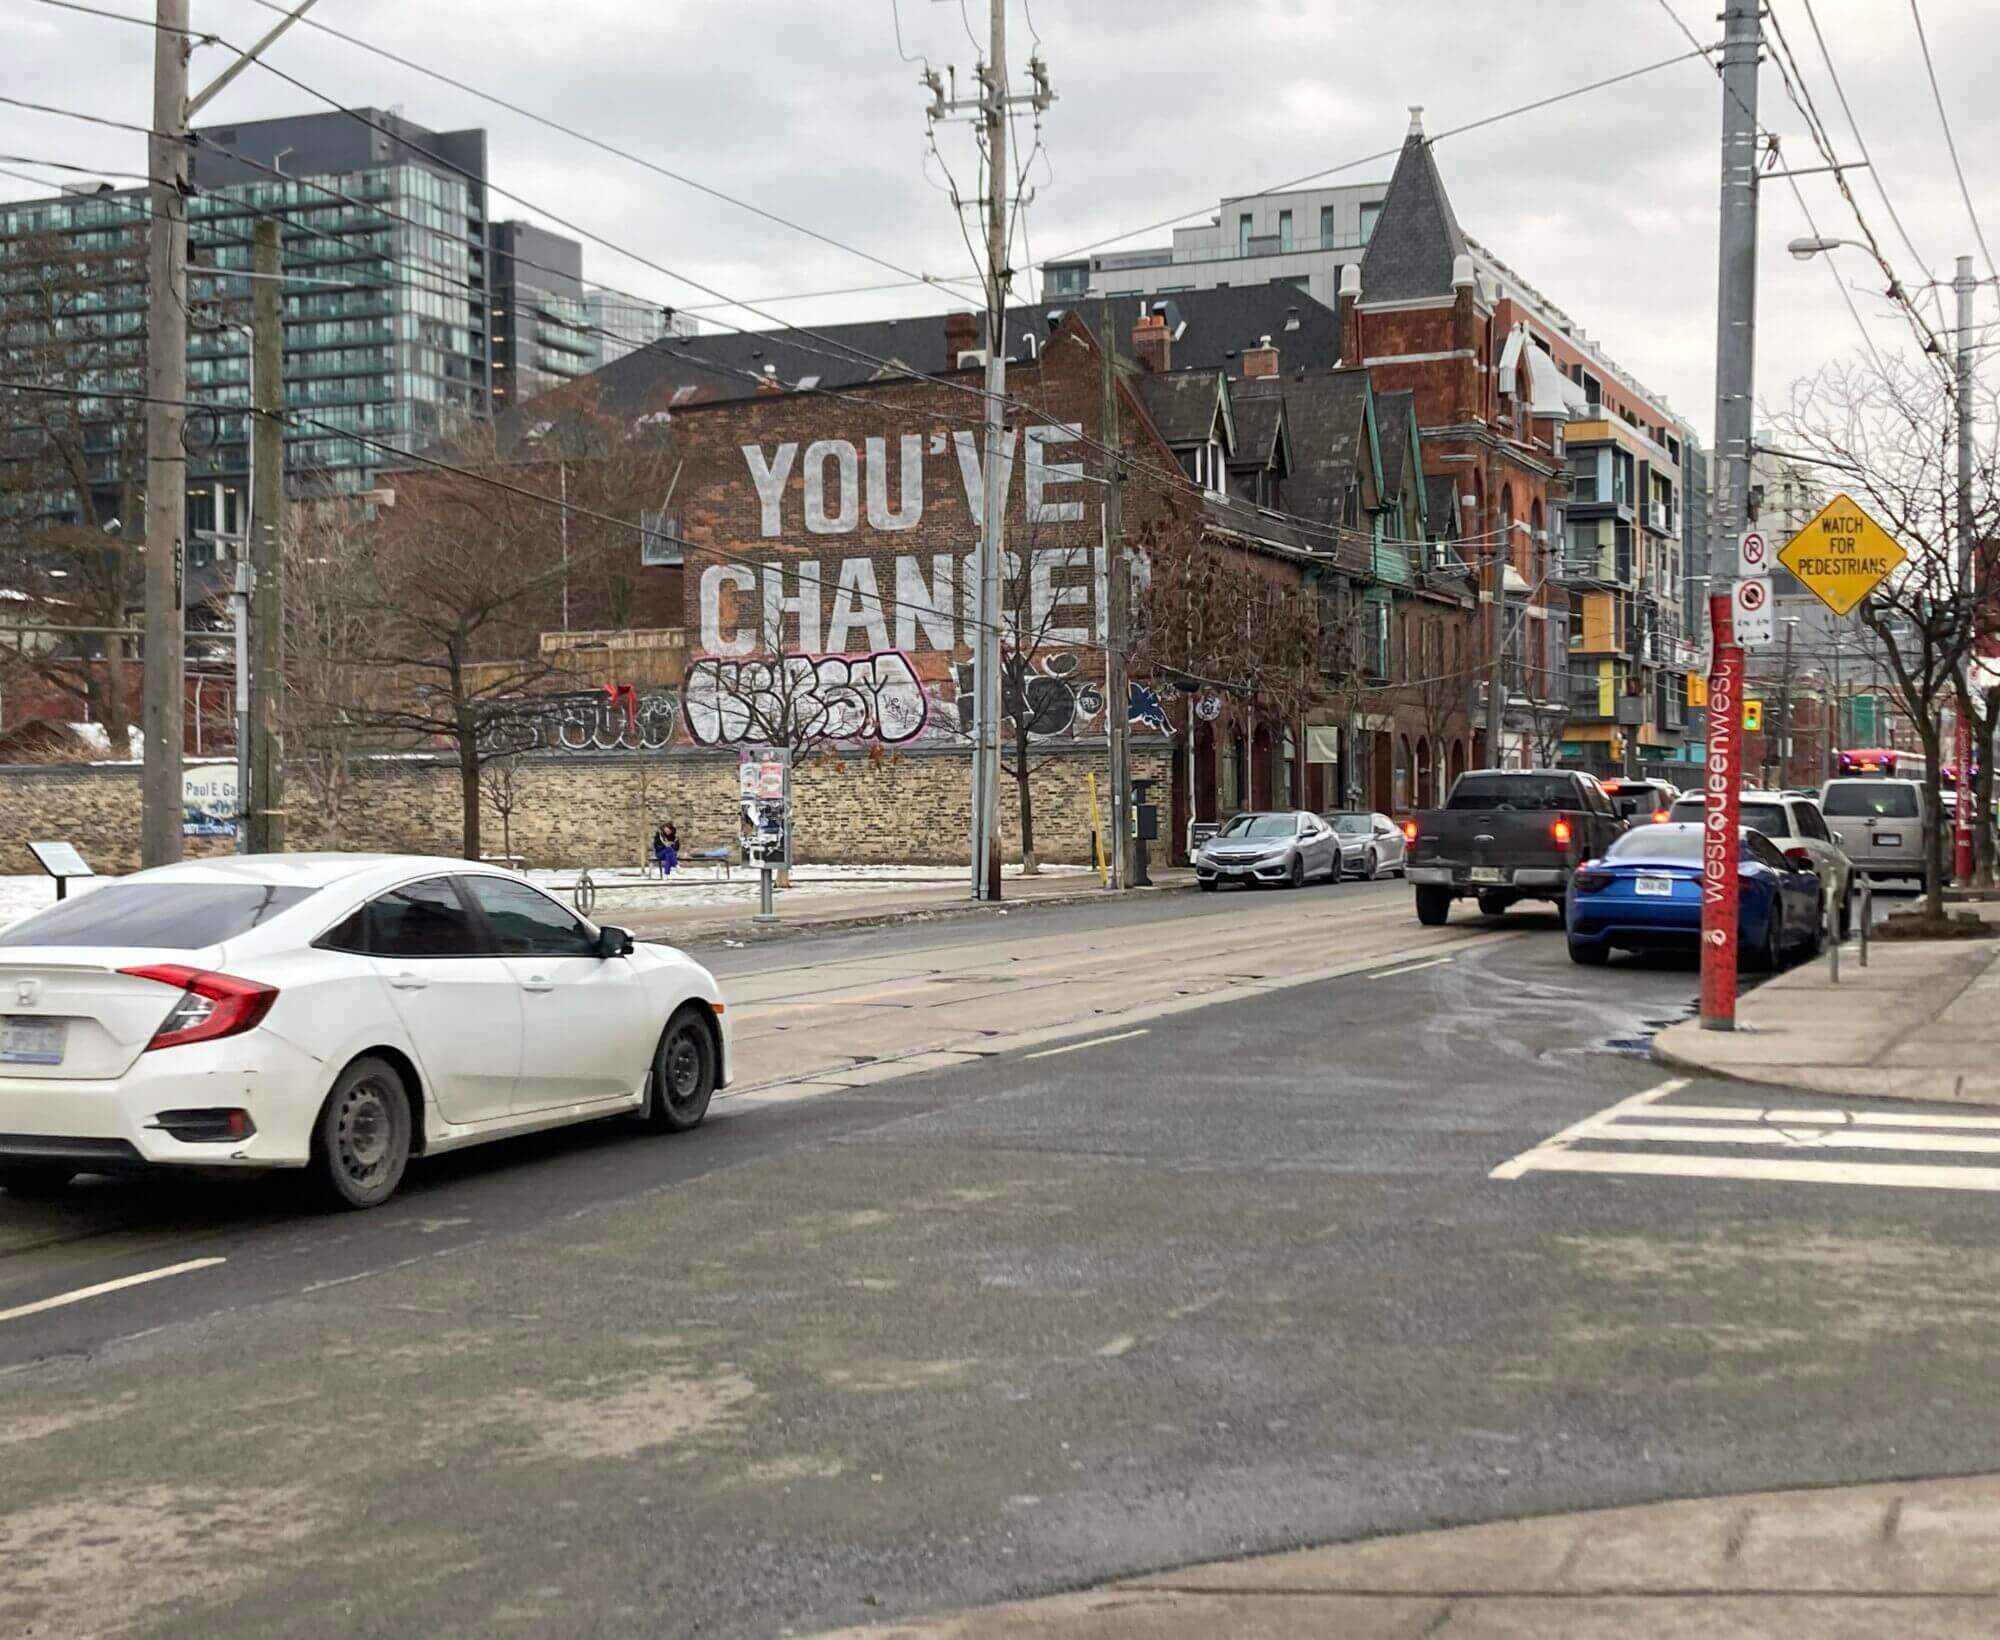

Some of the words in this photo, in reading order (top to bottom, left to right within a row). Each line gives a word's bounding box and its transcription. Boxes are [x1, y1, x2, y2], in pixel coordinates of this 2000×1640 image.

[742, 423, 1085, 537] YOU'VE
[1821, 517, 1863, 534] WATCH
[1830, 537, 1855, 554] FOR
[1798, 558, 1887, 576] PEDESTRIANS
[186, 782, 208, 796] Paul
